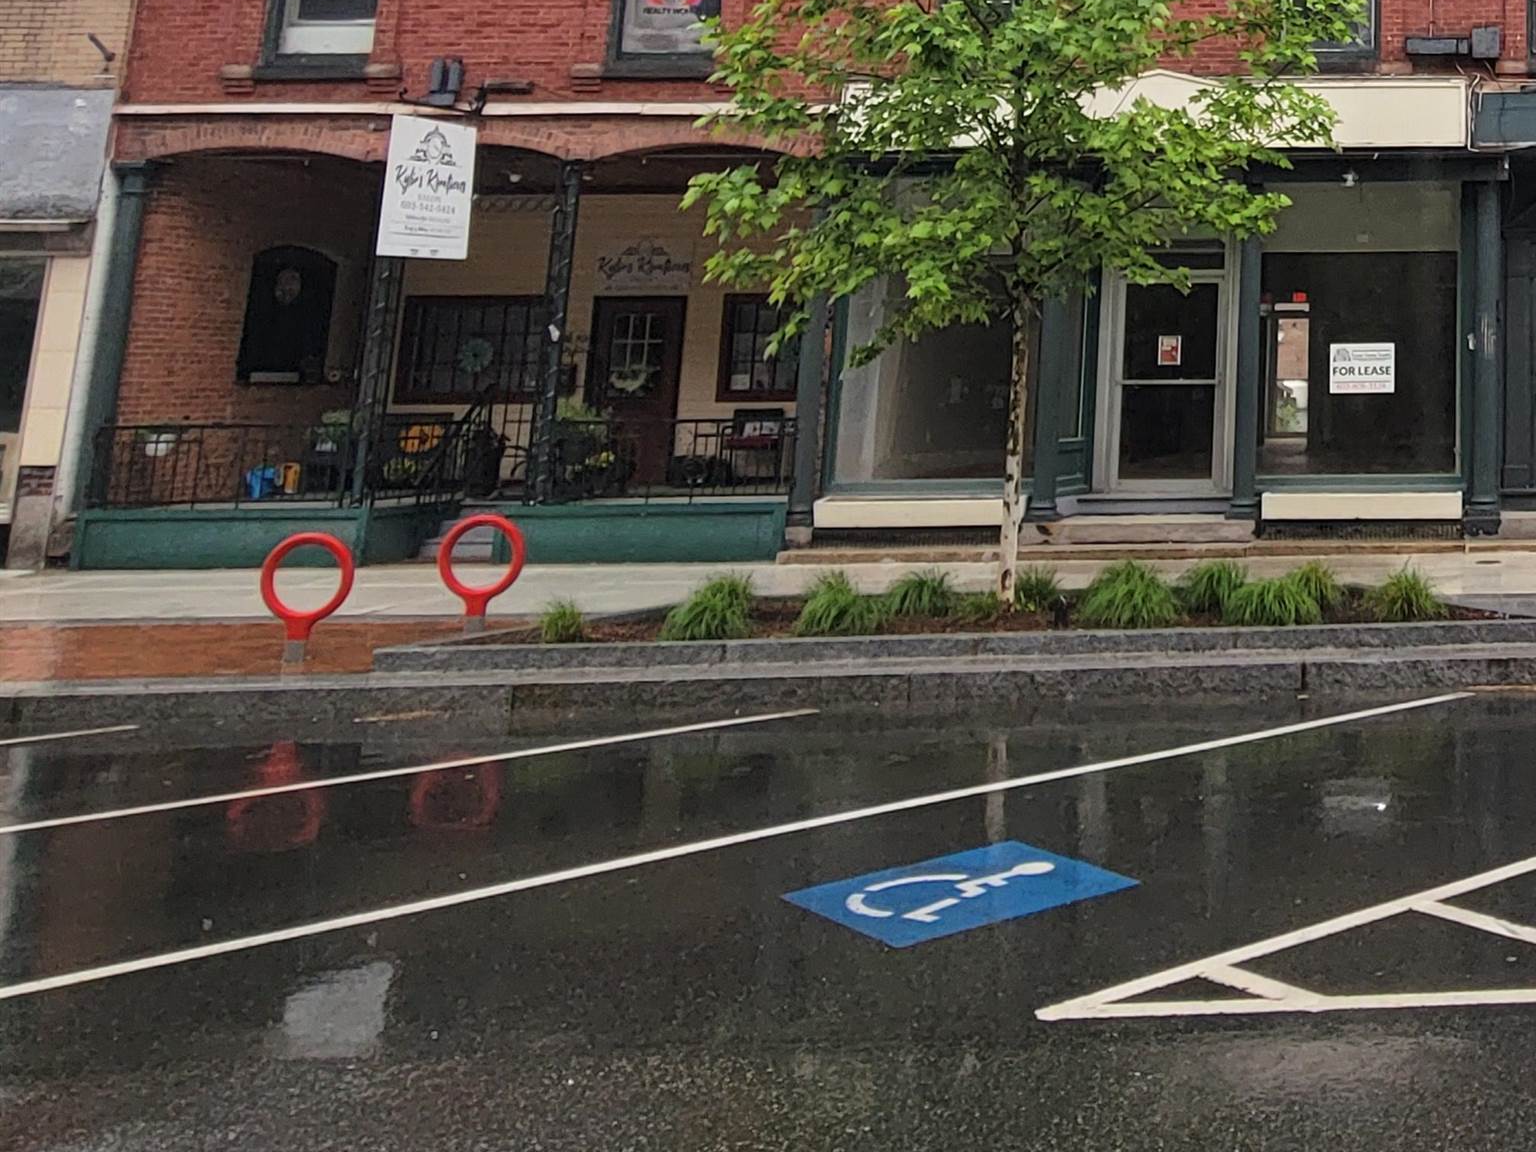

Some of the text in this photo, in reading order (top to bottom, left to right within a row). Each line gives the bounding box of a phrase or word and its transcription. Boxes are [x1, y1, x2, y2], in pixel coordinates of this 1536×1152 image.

[643, 7, 671, 15] REALTY
[1332, 365, 1392, 377] FOR LEASE
